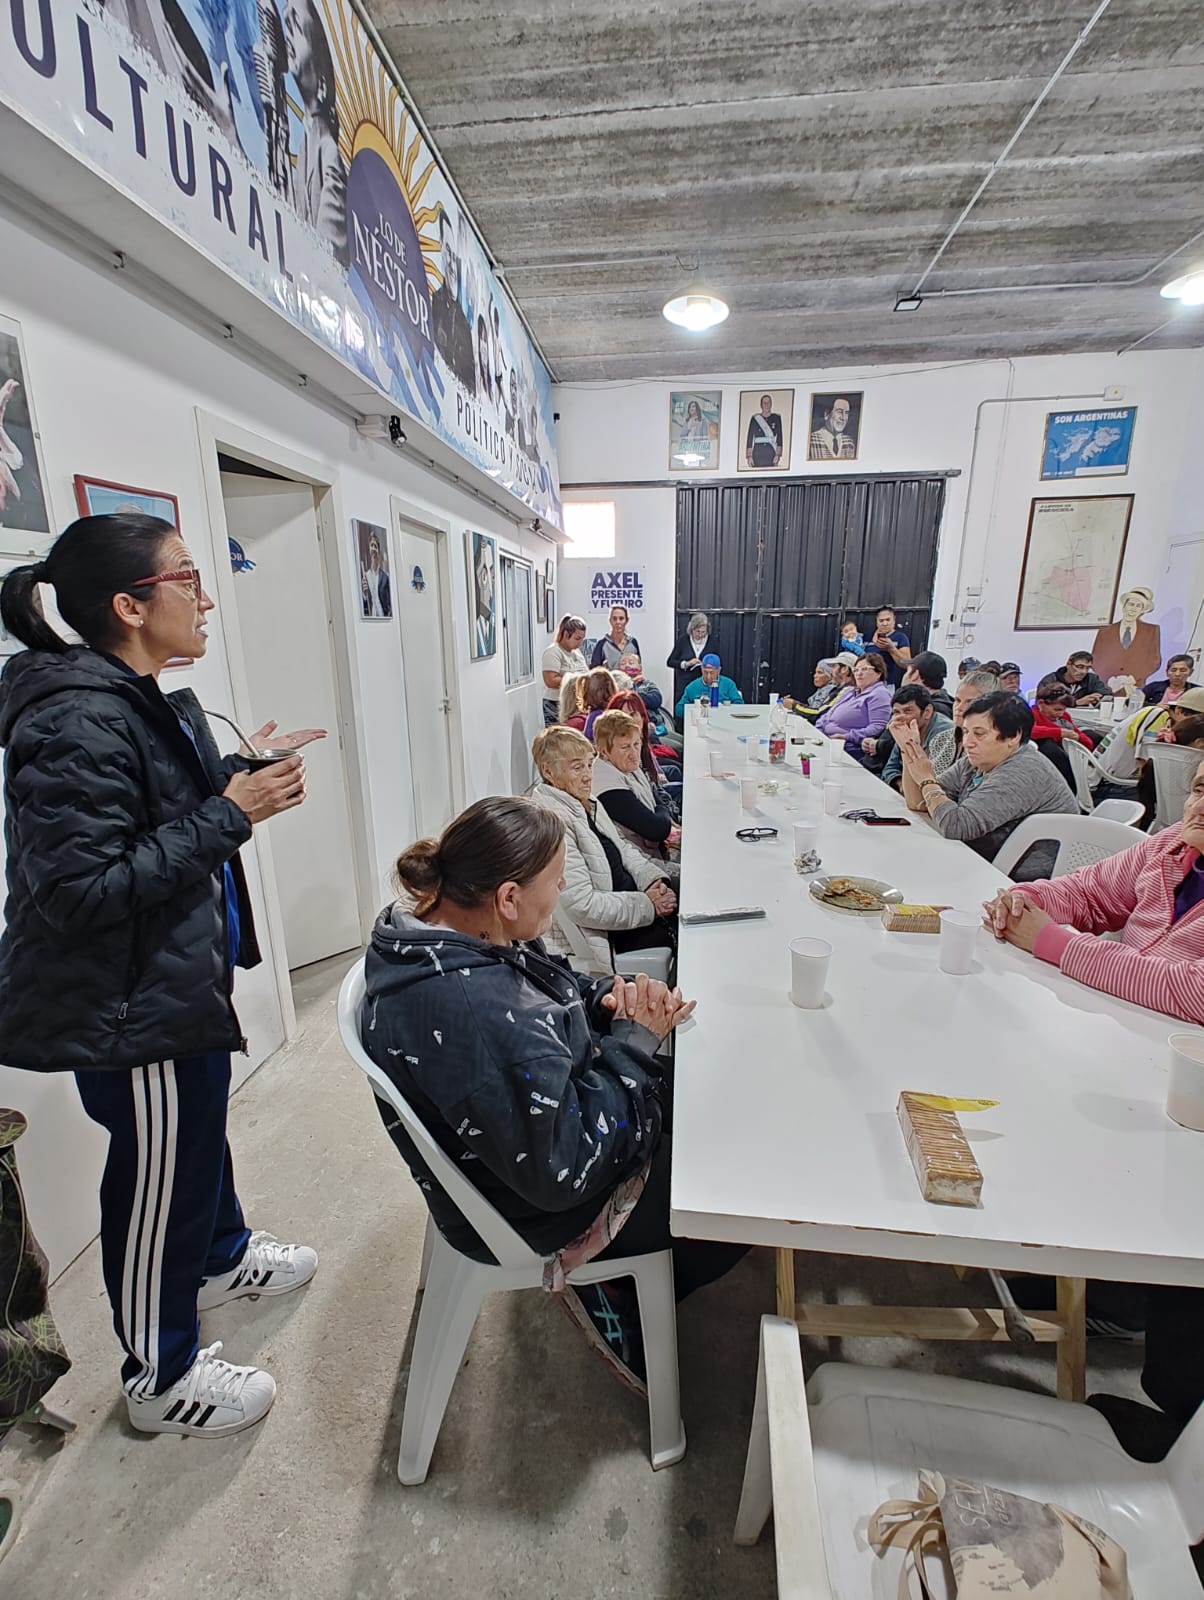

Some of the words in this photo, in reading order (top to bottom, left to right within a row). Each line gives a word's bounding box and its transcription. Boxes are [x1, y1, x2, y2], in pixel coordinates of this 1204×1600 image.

[379, 211, 393, 248] LO
[394, 232, 407, 265] DE
[352, 209, 431, 341] NÉSTOR
[1054, 415, 1073, 424] SON
[1073, 411, 1129, 423] ARGENTINAS
[456, 391, 506, 465] POLÍTICO
[591, 572, 643, 589] AXEL
[591, 589, 643, 599] PRESENTE
[591, 599, 599, 609] Y
